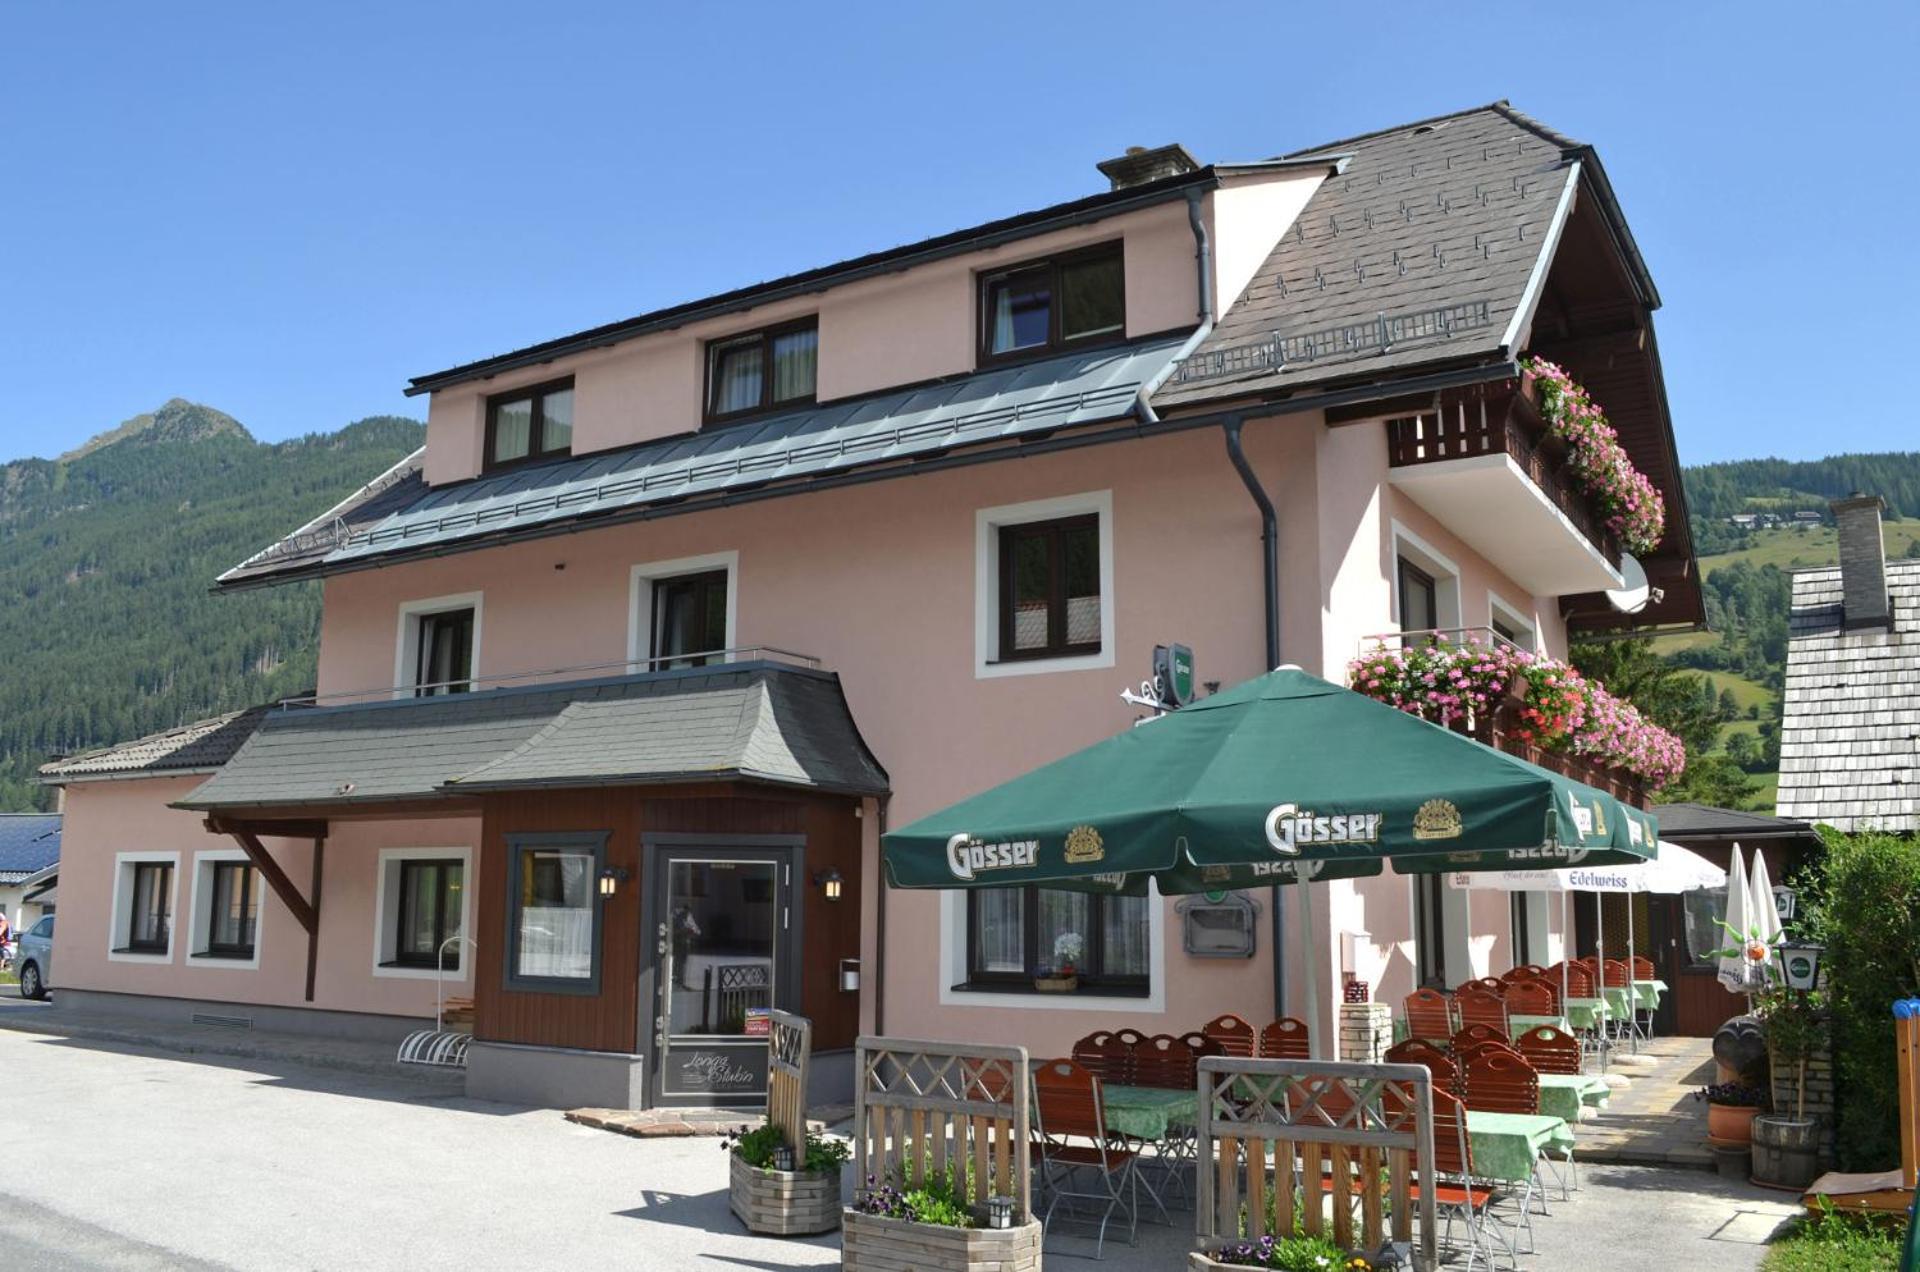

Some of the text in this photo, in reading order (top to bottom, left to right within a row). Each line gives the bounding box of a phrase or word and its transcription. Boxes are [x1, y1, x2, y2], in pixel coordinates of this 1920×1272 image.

[1265, 802, 1382, 855] Gösser
[946, 832, 1039, 881] Gösser
[1569, 870, 1628, 888] Edelweiss
